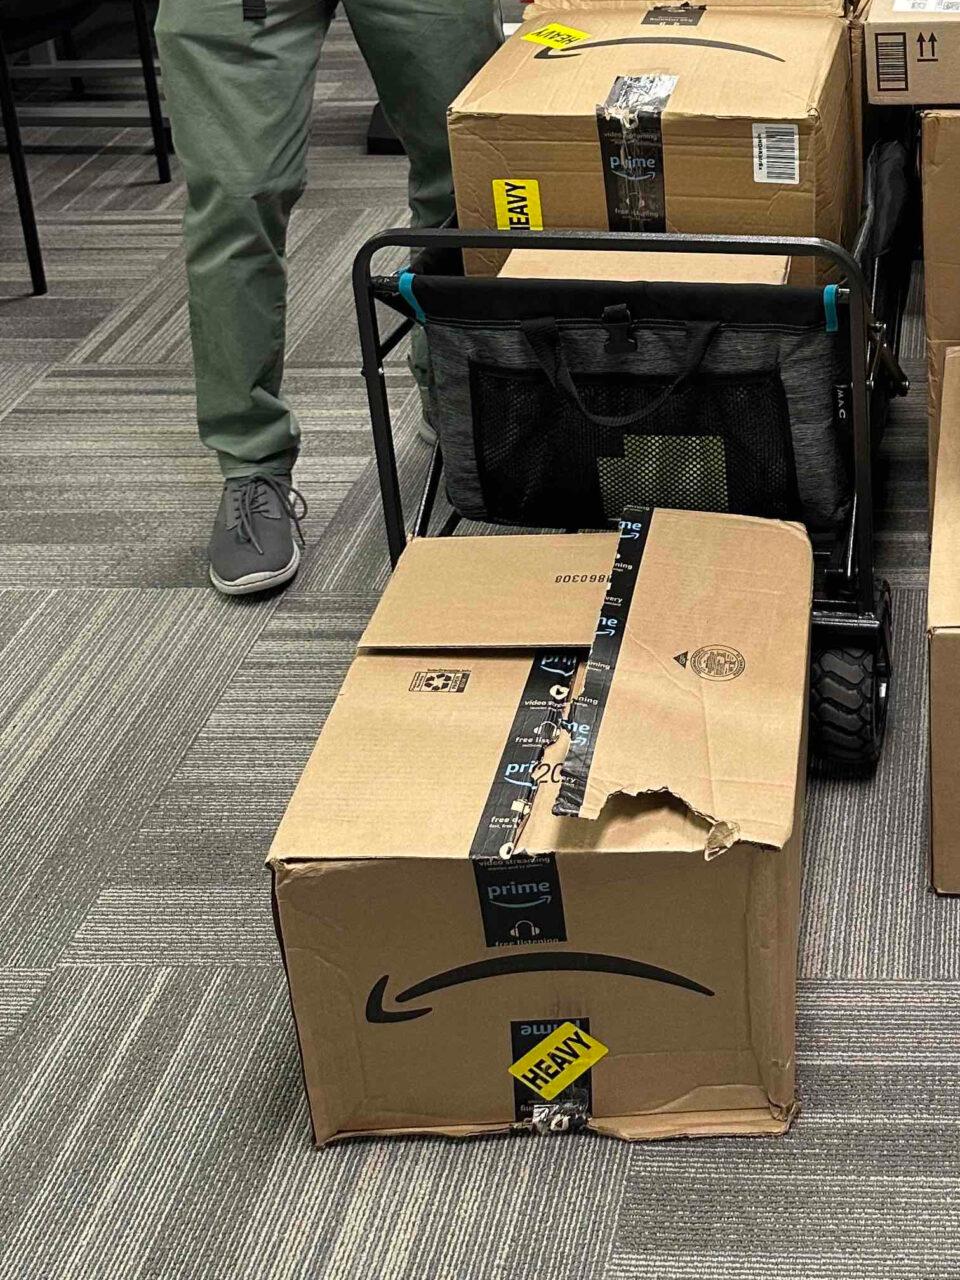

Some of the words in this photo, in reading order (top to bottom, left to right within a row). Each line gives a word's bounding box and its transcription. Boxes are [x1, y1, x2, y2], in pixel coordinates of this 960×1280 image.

[524, 699, 547, 707] video
[515, 736, 532, 744] free
[491, 816, 512, 824] free
[479, 859, 503, 867] video
[487, 881, 550, 899] prime
[521, 1030, 591, 1091] HEAVY
